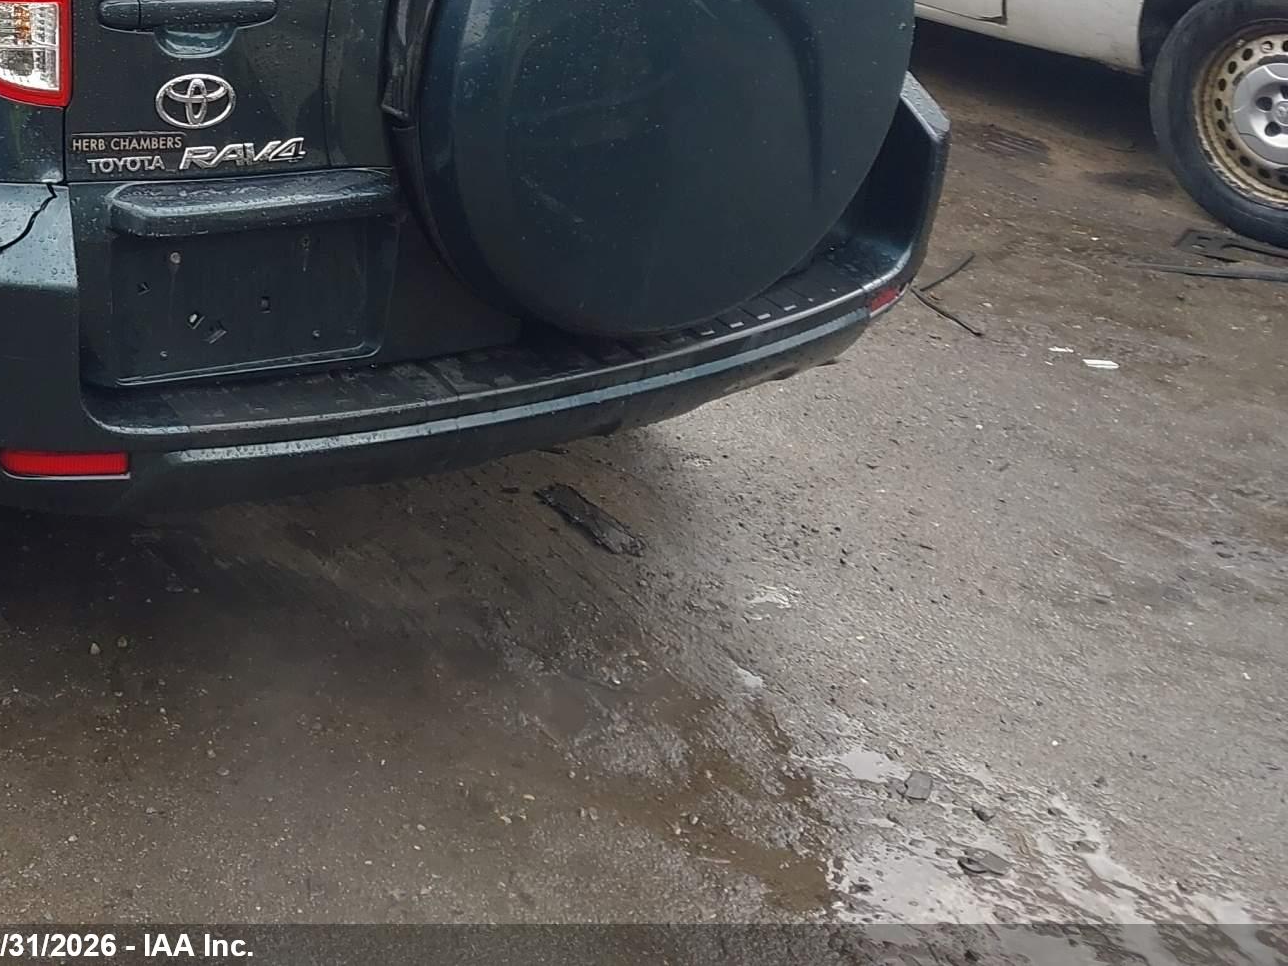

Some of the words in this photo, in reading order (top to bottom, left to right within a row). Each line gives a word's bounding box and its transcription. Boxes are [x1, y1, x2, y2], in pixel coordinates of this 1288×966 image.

[72, 138, 106, 151] HERB
[110, 136, 183, 151] CHAMBERS
[178, 137, 307, 170] RAV4
[86, 155, 166, 174] TOYOTA
